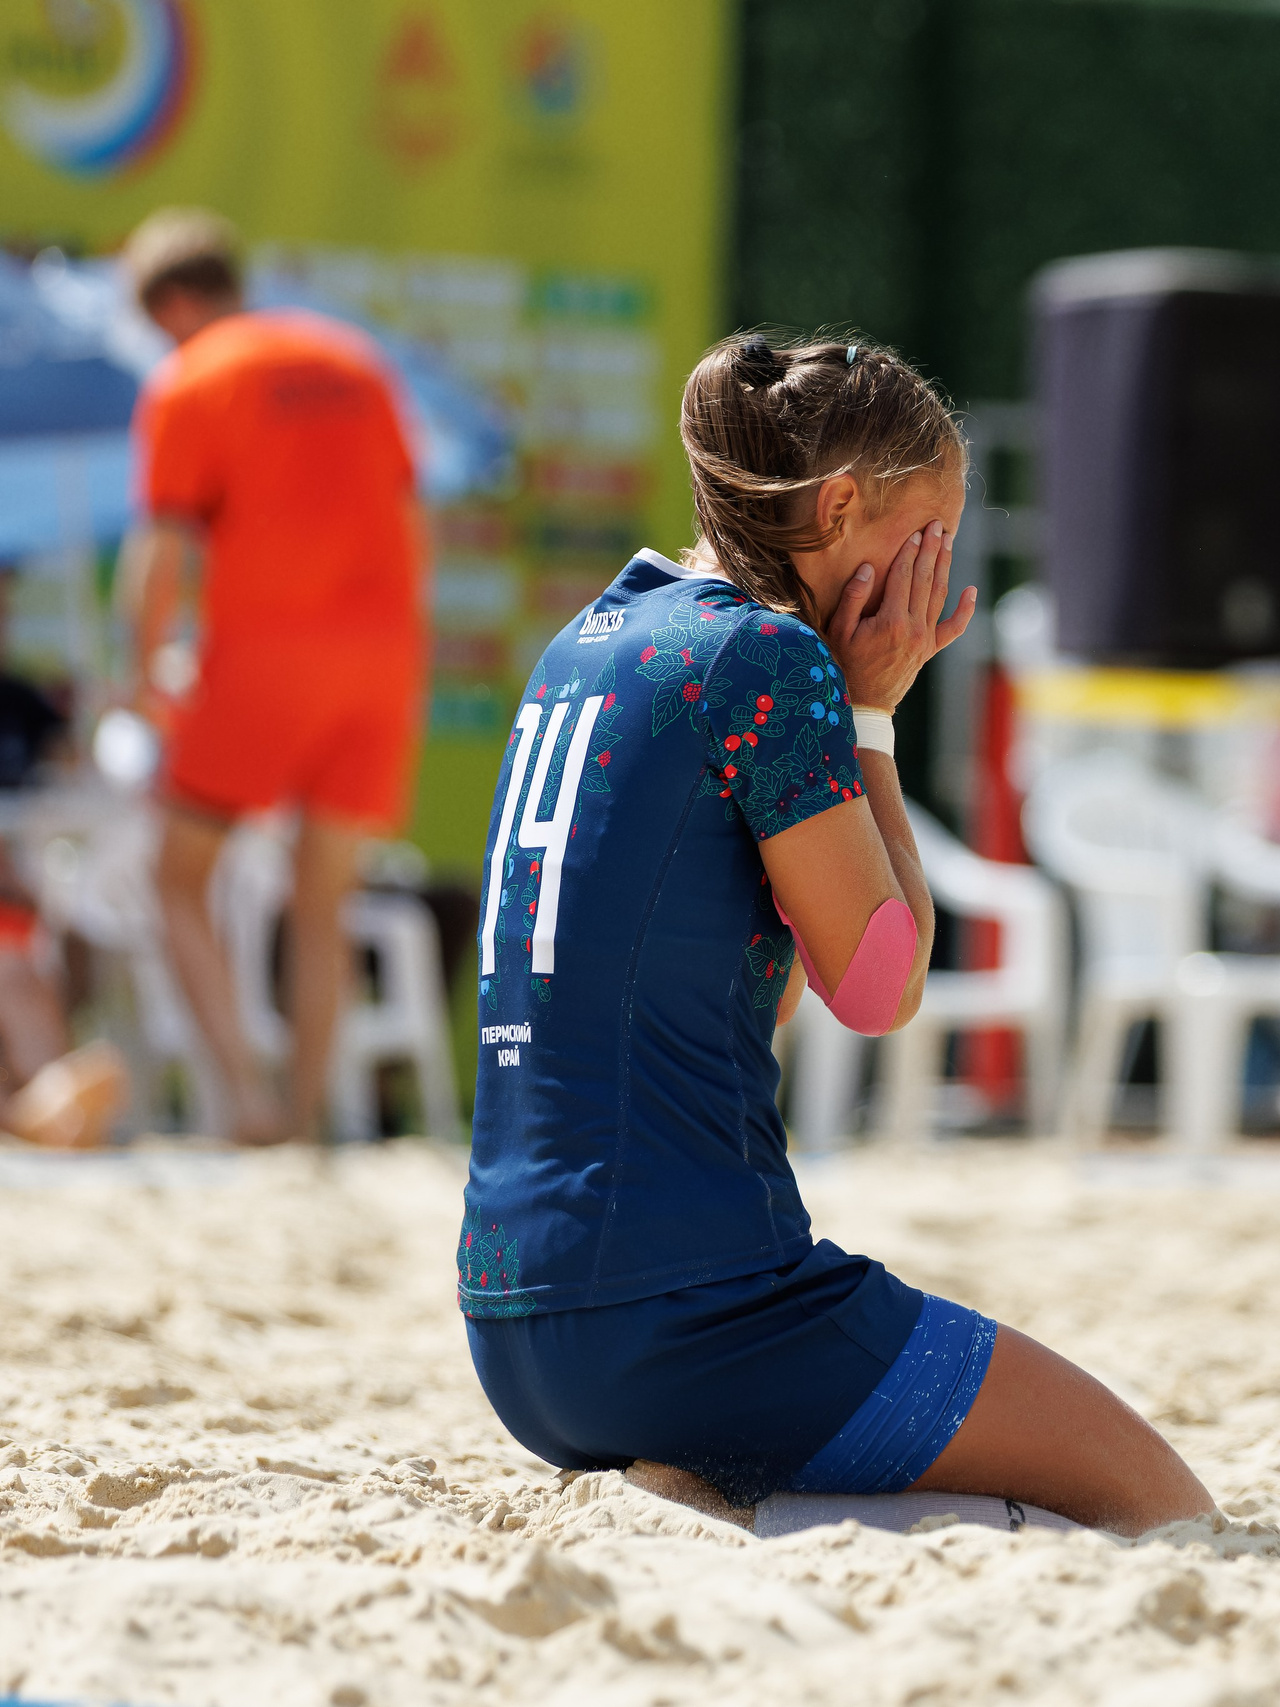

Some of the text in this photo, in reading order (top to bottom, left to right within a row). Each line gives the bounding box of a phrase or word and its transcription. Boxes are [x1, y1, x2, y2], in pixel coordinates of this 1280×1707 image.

[481, 695, 604, 976] 14
[481, 1021, 532, 1045] ПЕРМСКИЙ
[497, 1044, 520, 1067] КРАЙ
